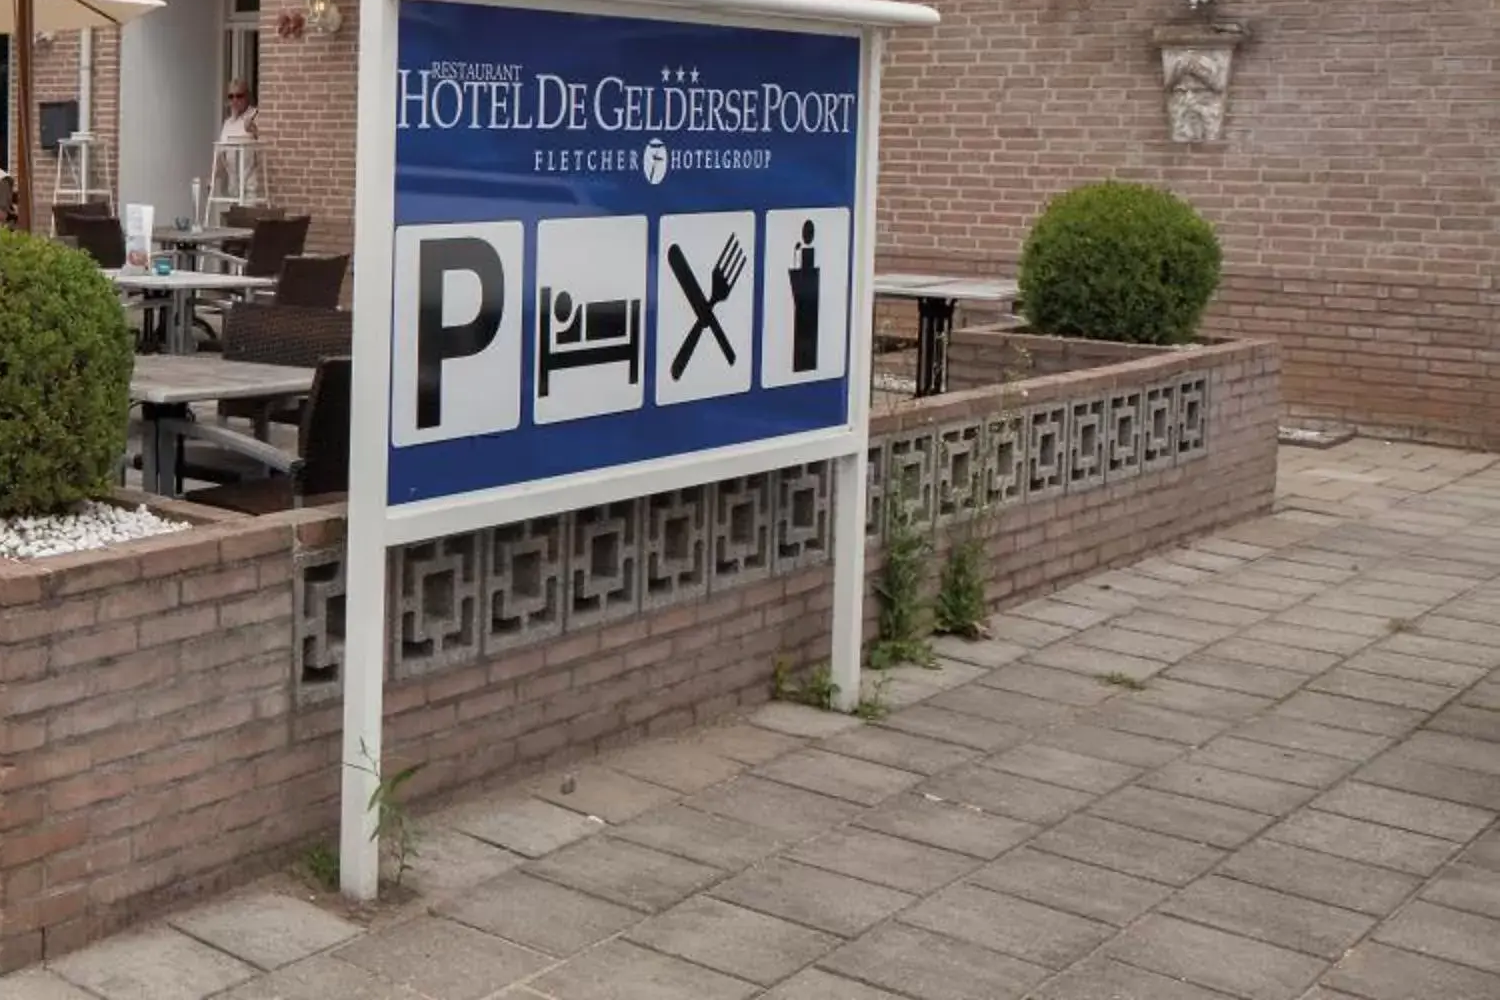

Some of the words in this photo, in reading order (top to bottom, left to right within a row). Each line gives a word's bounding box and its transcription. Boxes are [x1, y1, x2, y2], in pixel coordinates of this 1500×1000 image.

[430, 61, 524, 81] RESTAURANT
[397, 69, 533, 130] HOTEL
[593, 76, 757, 132] GELDERSE
[761, 83, 855, 133] POORT
[534, 149, 639, 171] FLETCHER
[671, 149, 772, 169] HOTELGROUP
[416, 236, 505, 430] P
